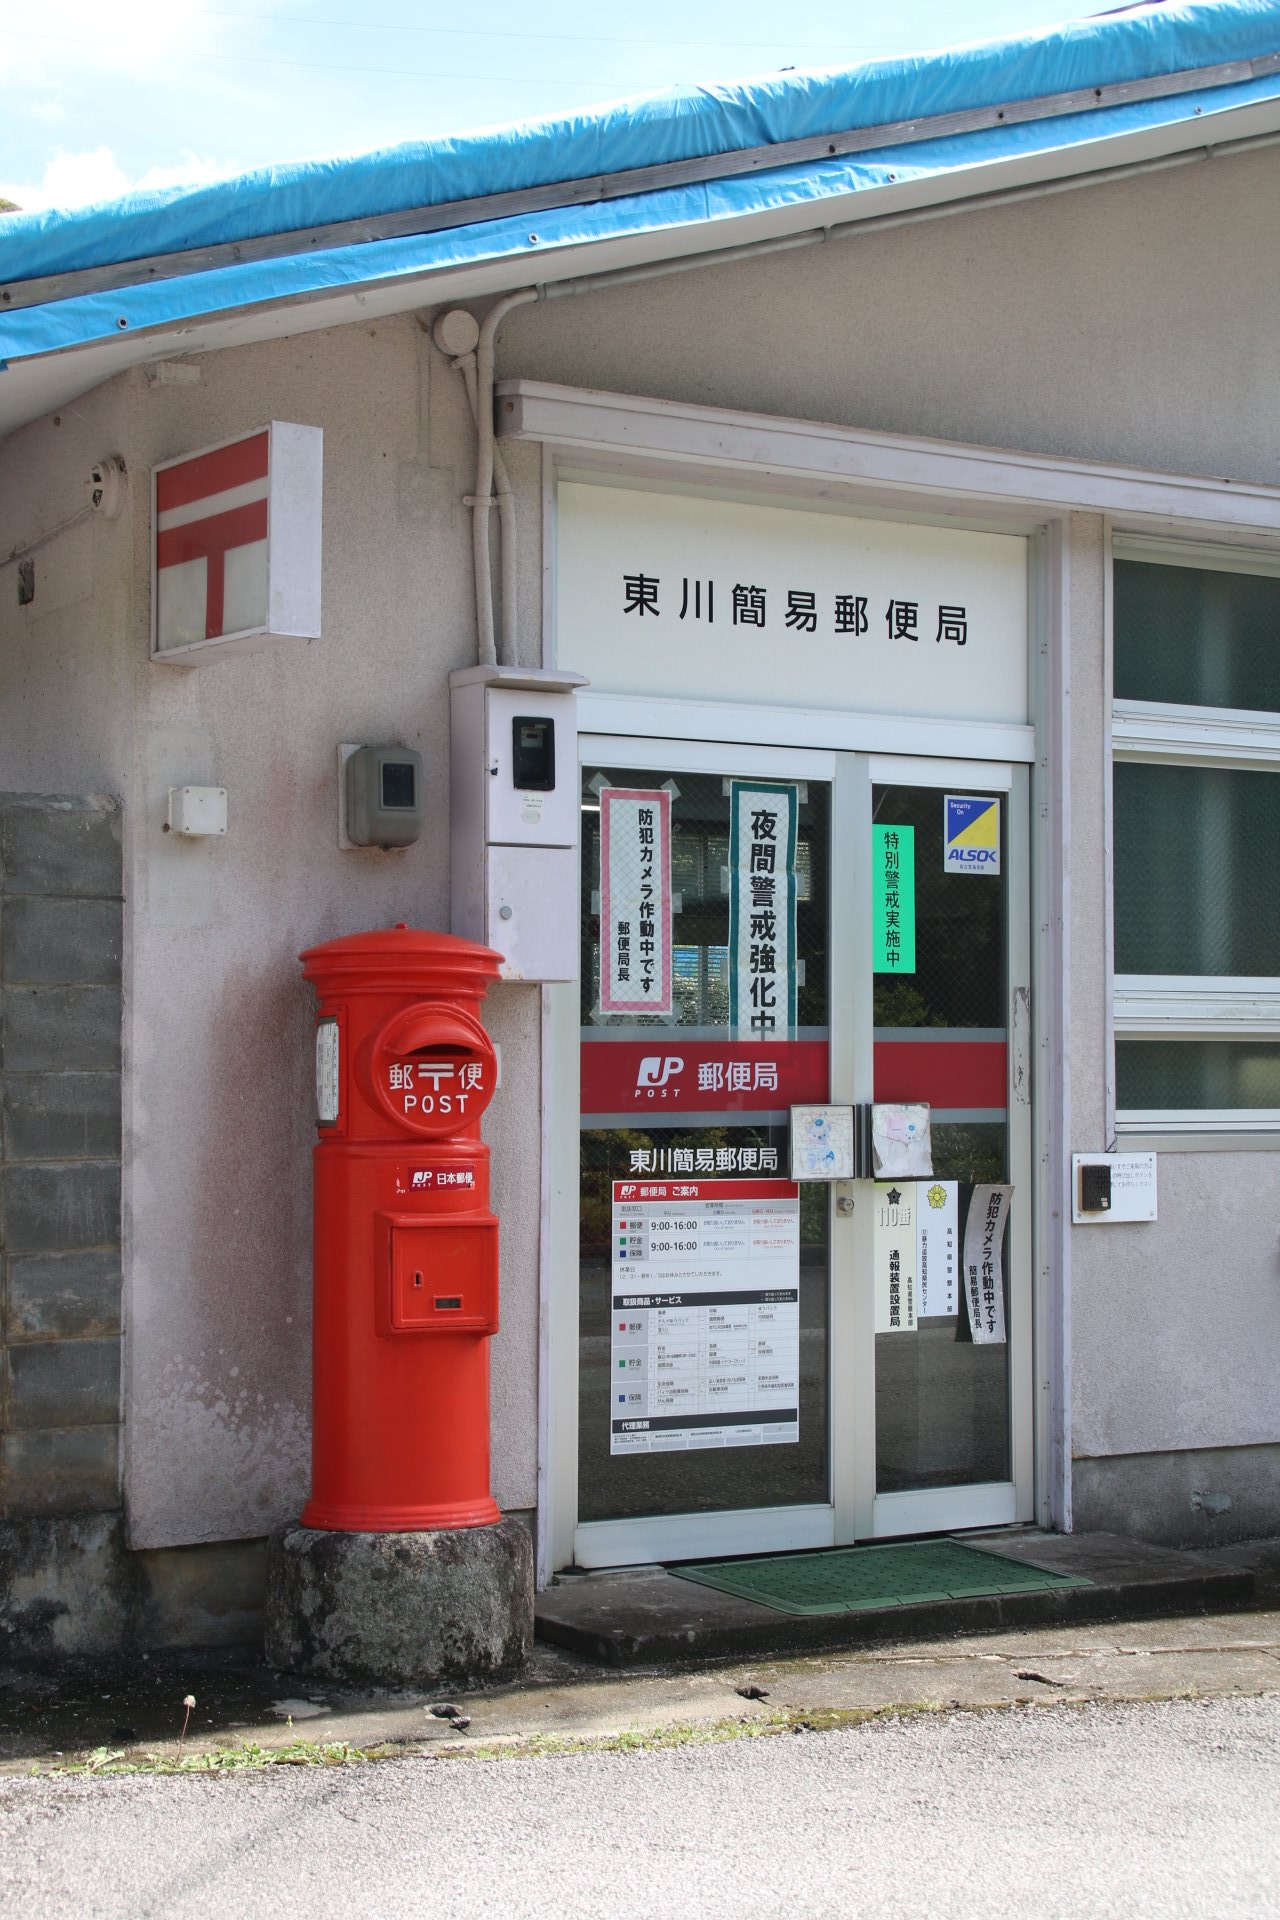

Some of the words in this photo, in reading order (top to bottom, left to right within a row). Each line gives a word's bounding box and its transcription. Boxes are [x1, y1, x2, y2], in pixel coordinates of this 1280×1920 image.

[623, 573, 967, 646] 東川簡易郵便局
[950, 802, 971, 810] Security
[948, 849, 997, 863] ALSOK
[638, 808, 655, 993] 防犯カメラ作動中です
[884, 831, 901, 968] 特別警戒実施中
[749, 809, 778, 1041] 夜間警戒強化中
[617, 921, 631, 982] 郵便局長
[698, 1062, 778, 1092] 郵便局
[634, 1088, 681, 1098] POST
[404, 1094, 469, 1114] POST
[629, 1147, 778, 1173] 東川簡易郵便局
[640, 1187, 667, 1197] 郵便局
[672, 1185, 699, 1197] ご案内
[629, 1221, 643, 1229] 郵便
[651, 1220, 697, 1231] 9:00-16:00
[629, 1237, 643, 1245] 貯金
[651, 1241, 697, 1251] 9:00-16:00
[981, 1192, 1003, 1334] 防犯カメラ作動中です
[889, 1249, 900, 1327] 通報装置設置局
[622, 1296, 682, 1306] 取扱商品・サービス
[969, 1265, 983, 1329] 簡易郵便局長
[629, 1323, 643, 1331] 郵便
[629, 1359, 642, 1367] 貯金
[628, 1393, 642, 1401] 保険
